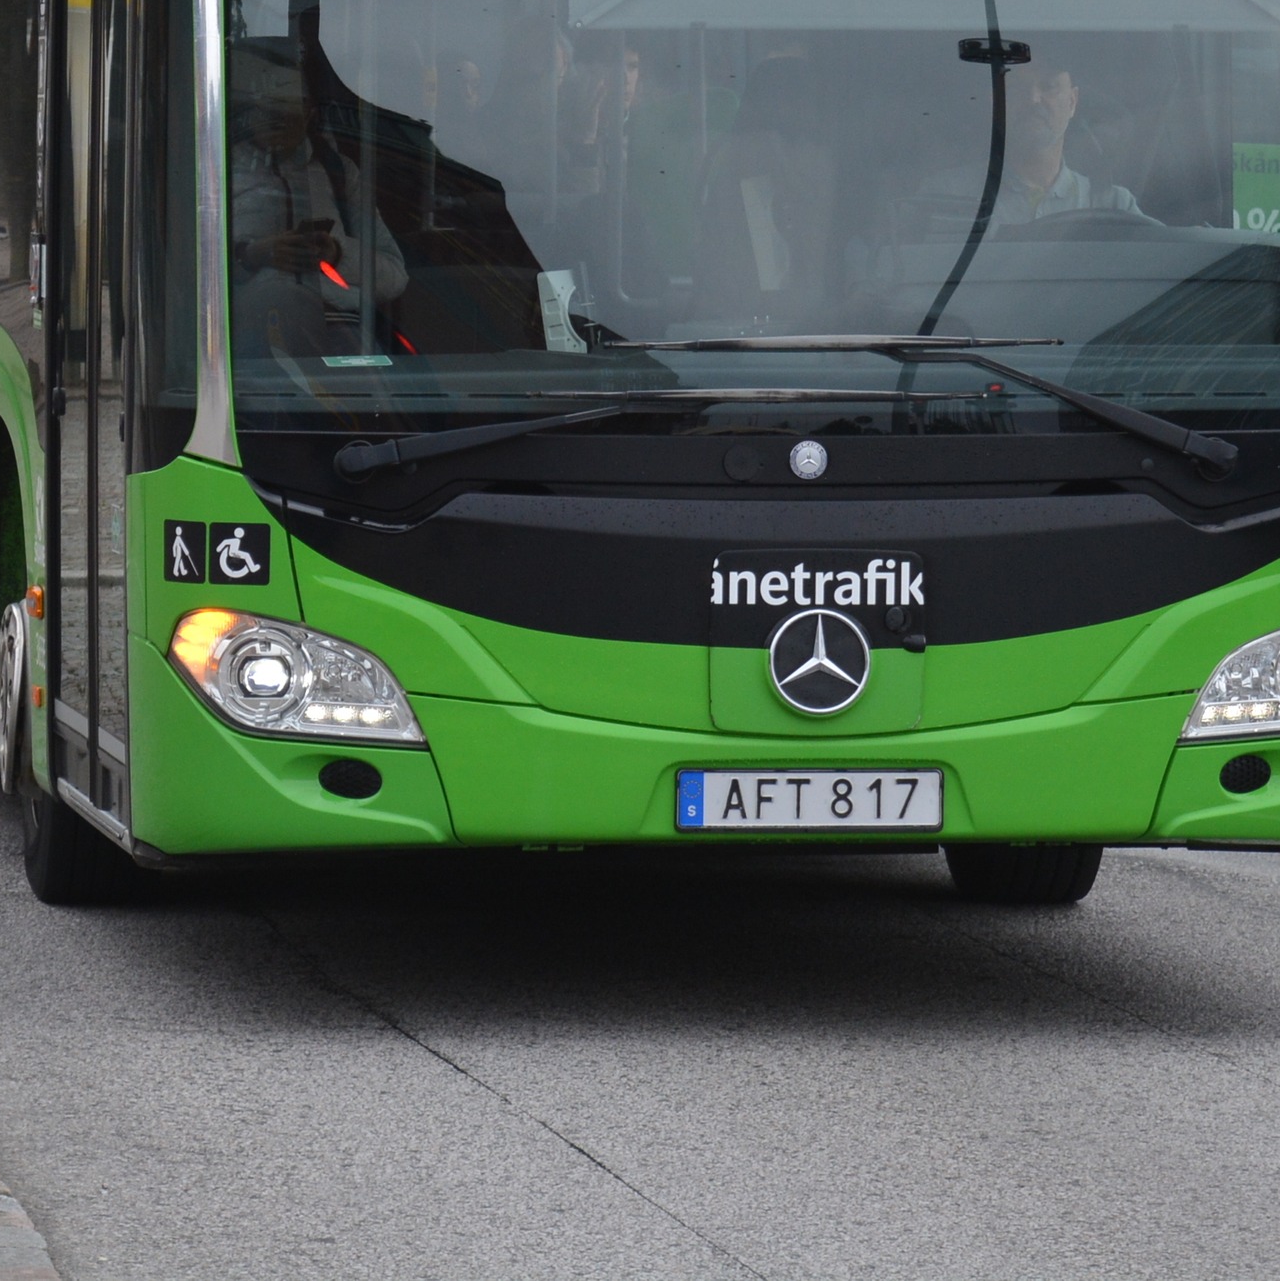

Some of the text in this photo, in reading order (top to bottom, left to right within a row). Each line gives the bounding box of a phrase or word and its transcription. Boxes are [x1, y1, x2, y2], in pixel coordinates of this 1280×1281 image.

[687, 778, 919, 820] S AFT 817
